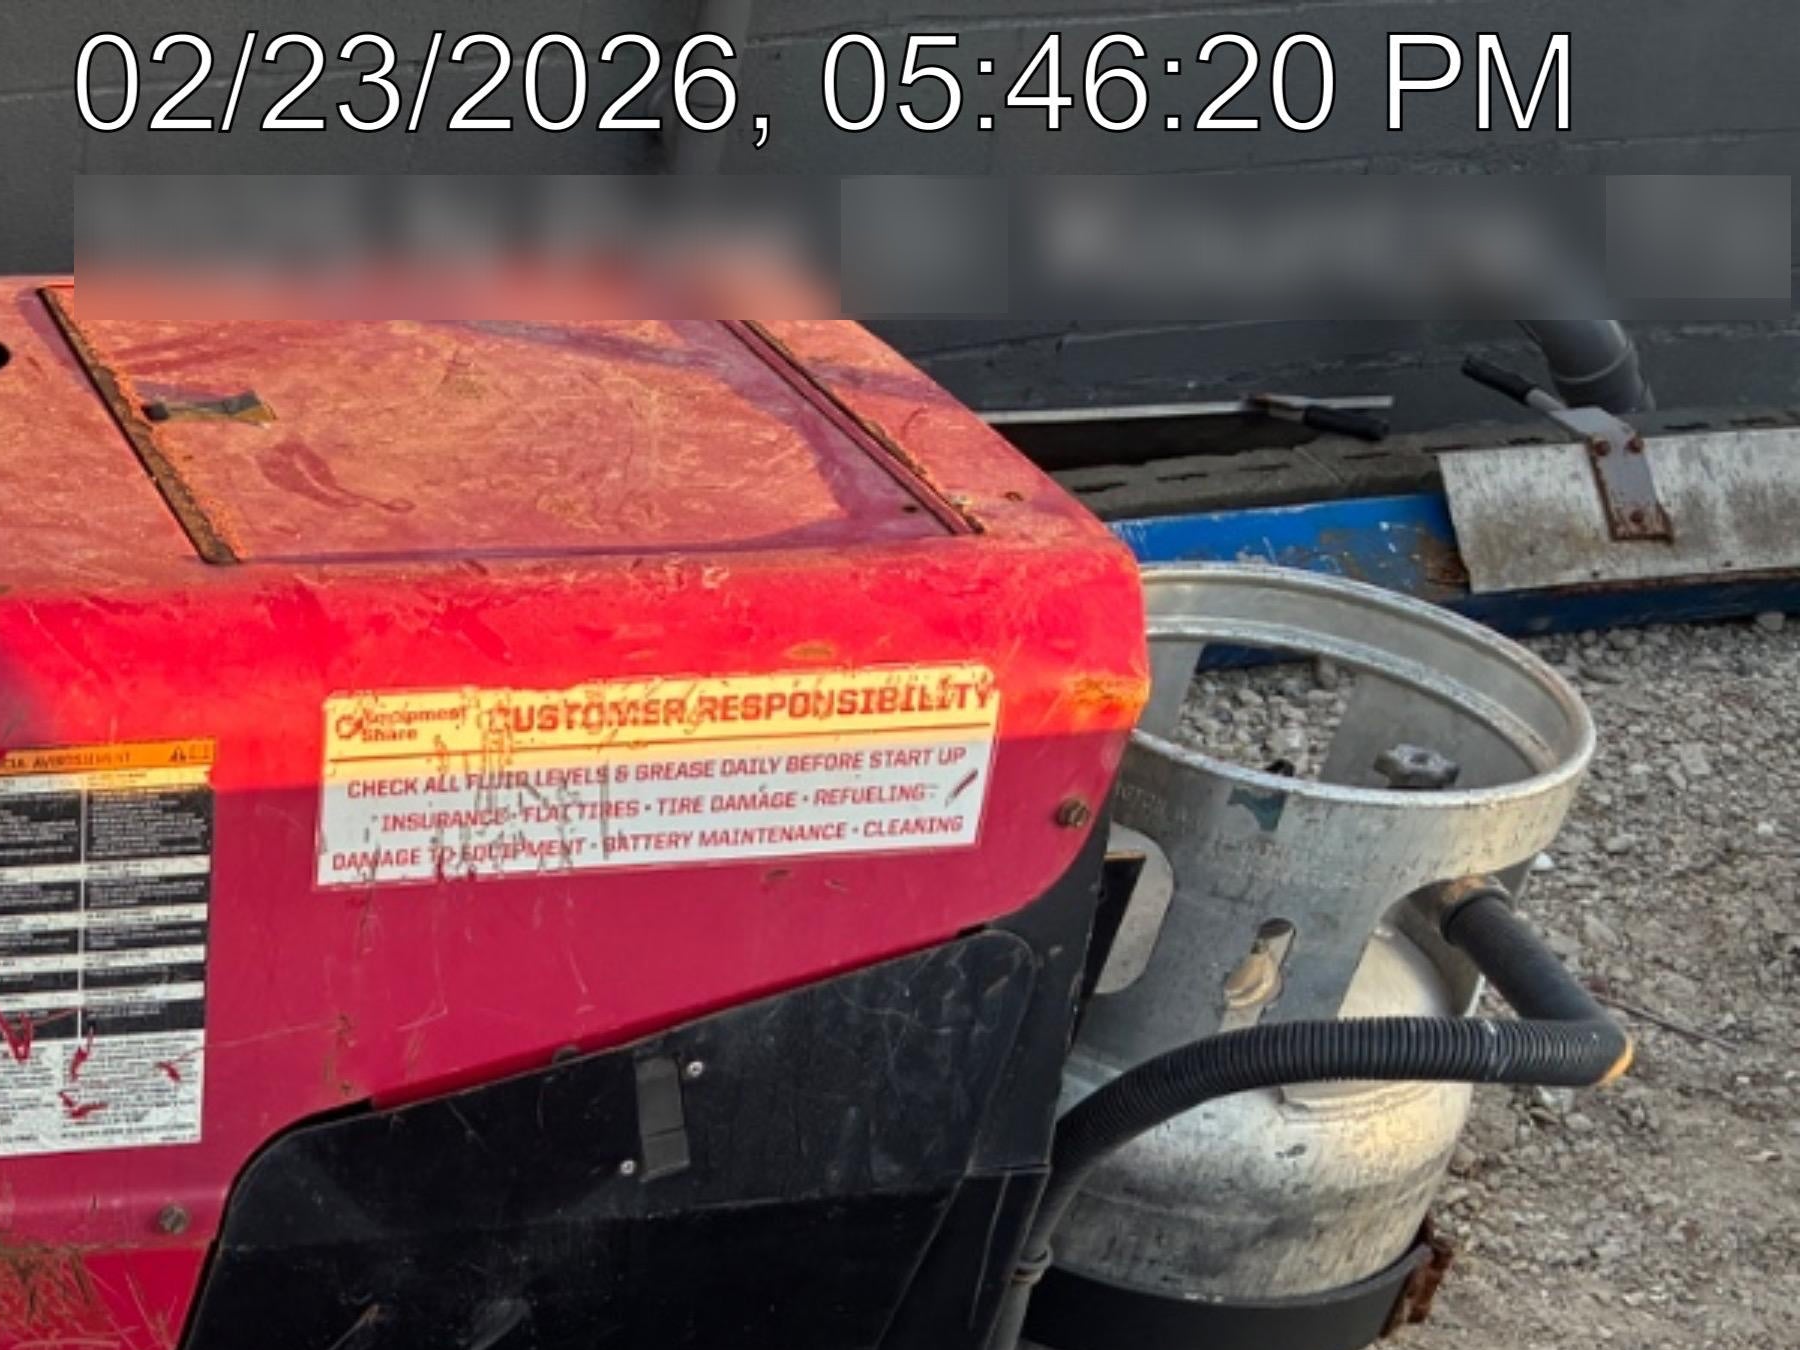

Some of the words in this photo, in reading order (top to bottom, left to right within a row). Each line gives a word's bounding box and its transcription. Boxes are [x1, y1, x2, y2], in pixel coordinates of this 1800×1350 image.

[494, 697, 687, 733] CUSTOMER
[698, 682, 993, 722] RESPONSIBILITY
[360, 726, 419, 743] Share
[347, 778, 418, 799] CHECK
[422, 774, 460, 794] ALL
[466, 770, 529, 791] FLUID
[534, 765, 609, 787] LEVELS
[635, 759, 716, 783] GREASE
[719, 756, 783, 777] DAILY
[785, 752, 863, 774] BEFORE
[869, 747, 933, 769] START
[938, 746, 968, 766] UP
[380, 809, 508, 833] INSURANCE
[521, 802, 572, 824] FLAT
[574, 799, 640, 821] TIRES
[658, 796, 704, 816] TIRE
[709, 791, 799, 813] DAMAGE
[812, 783, 926, 807] REFUELING
[331, 847, 421, 872] DAMAGE
[459, 836, 587, 864] EQUIPMENT
[603, 830, 693, 853] BATTERY
[699, 821, 847, 848] MAINTENANCE
[862, 815, 964, 839] CLEANING
